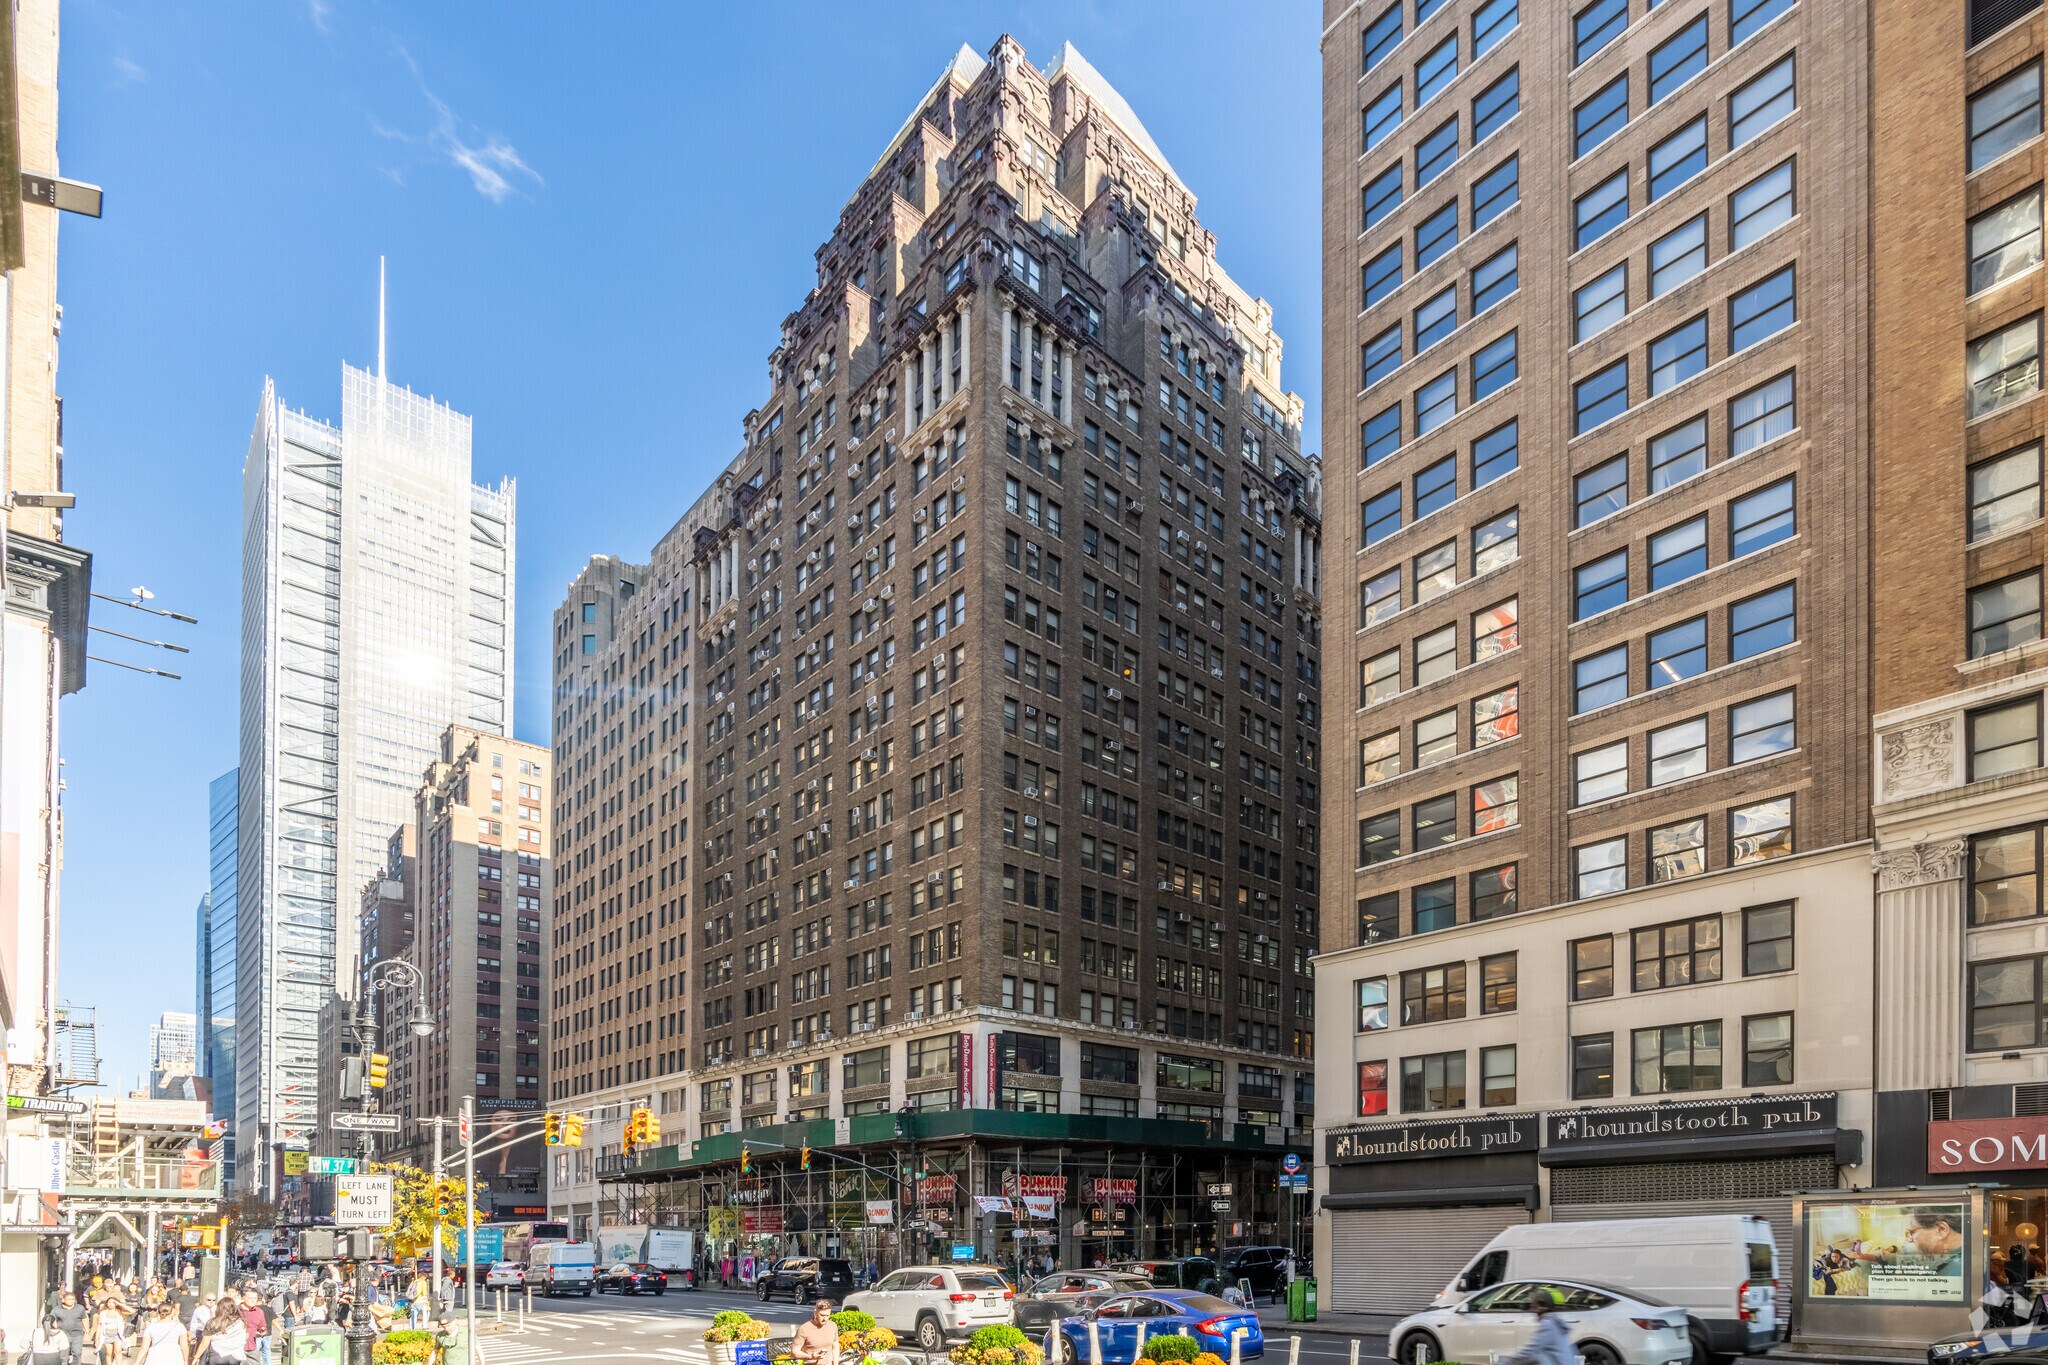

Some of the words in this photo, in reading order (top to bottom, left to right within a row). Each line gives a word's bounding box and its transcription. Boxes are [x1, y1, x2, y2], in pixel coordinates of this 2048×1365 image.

[1581, 1106, 1749, 1138] houndstooth
[1762, 1102, 1821, 1129] pub
[1353, 1125, 1472, 1156] houndstooth
[1481, 1121, 1522, 1150] pub
[1941, 1134, 2046, 1165] SOM
[322, 1160, 330, 1171] W
[333, 1160, 345, 1172] 37
[366, 1182, 387, 1190] LANE
[1021, 1175, 1068, 1189] DUNKIN'
[1097, 1178, 1137, 1191] DUNKIN'
[351, 1196, 378, 1204] MUST
